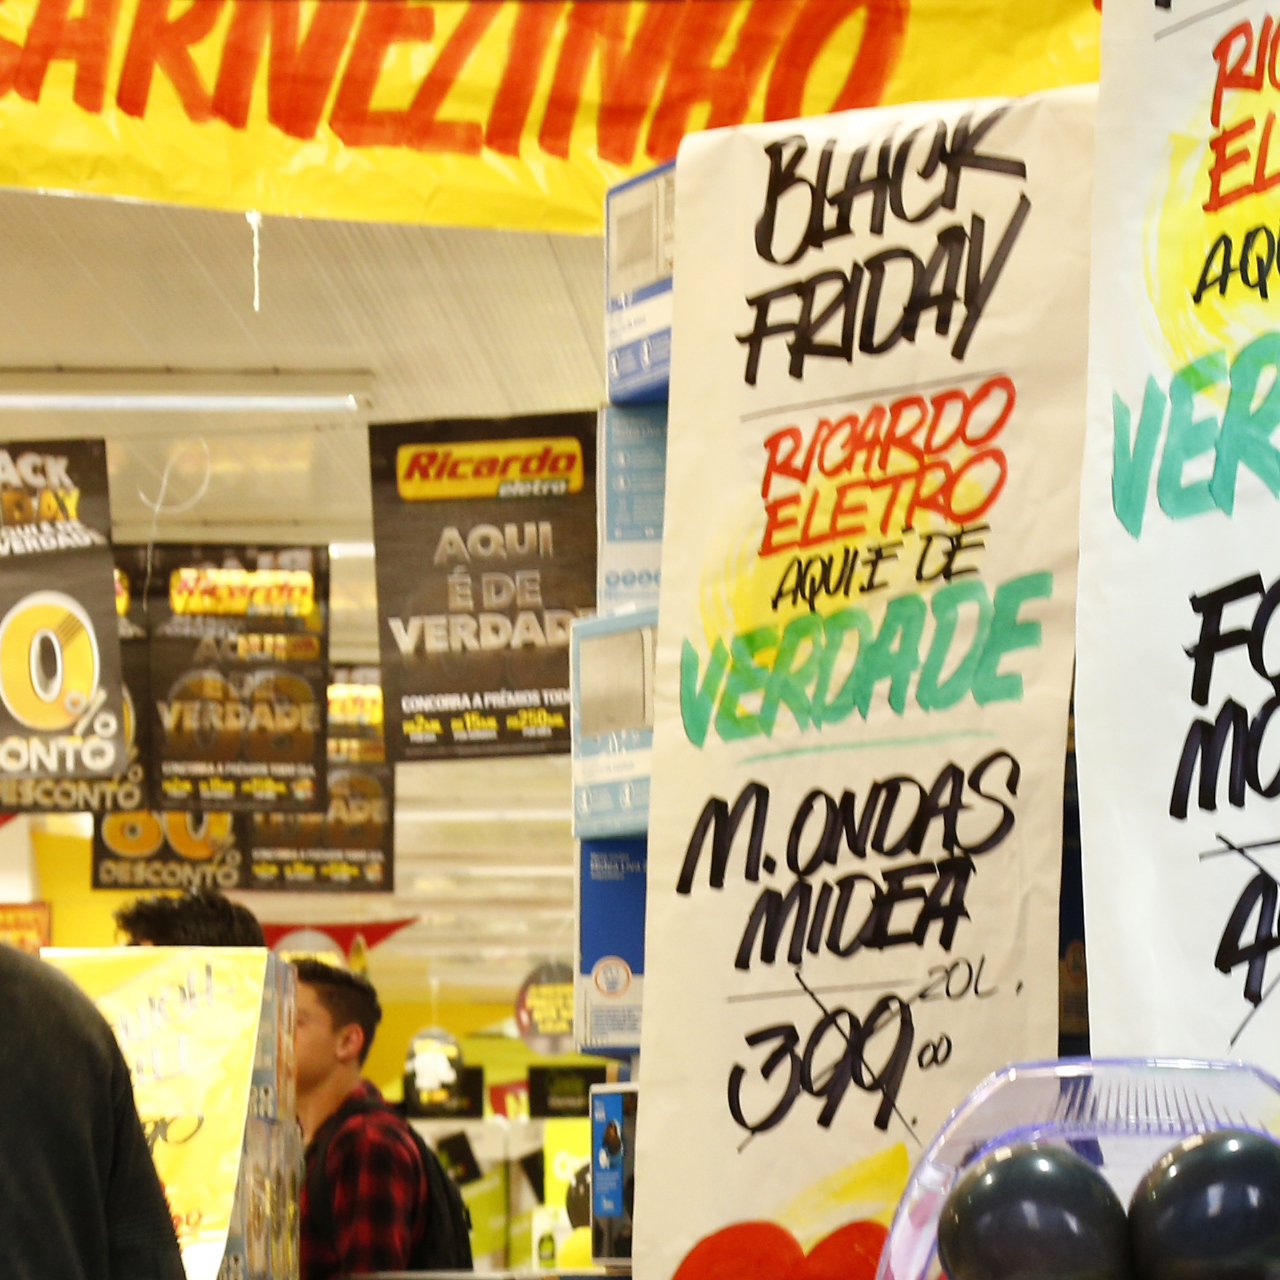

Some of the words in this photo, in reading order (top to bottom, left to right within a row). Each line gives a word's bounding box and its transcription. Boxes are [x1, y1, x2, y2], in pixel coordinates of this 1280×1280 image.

[755, 105, 1027, 265] BLACK
[735, 192, 1031, 386] FRIDAY
[403, 447, 577, 481] Ricardo
[761, 373, 1015, 499] RICARDO
[498, 478, 567, 497] eletro
[757, 447, 1007, 559] ELETRO
[433, 521, 553, 565] AQUI
[482, 568, 544, 608] DE
[772, 552, 856, 614] AQUI
[388, 607, 597, 656] VERDAD
[680, 571, 1053, 746] VERDADE
[99, 859, 240, 889] DESCONTO
[735, 857, 976, 970] MIDEA
